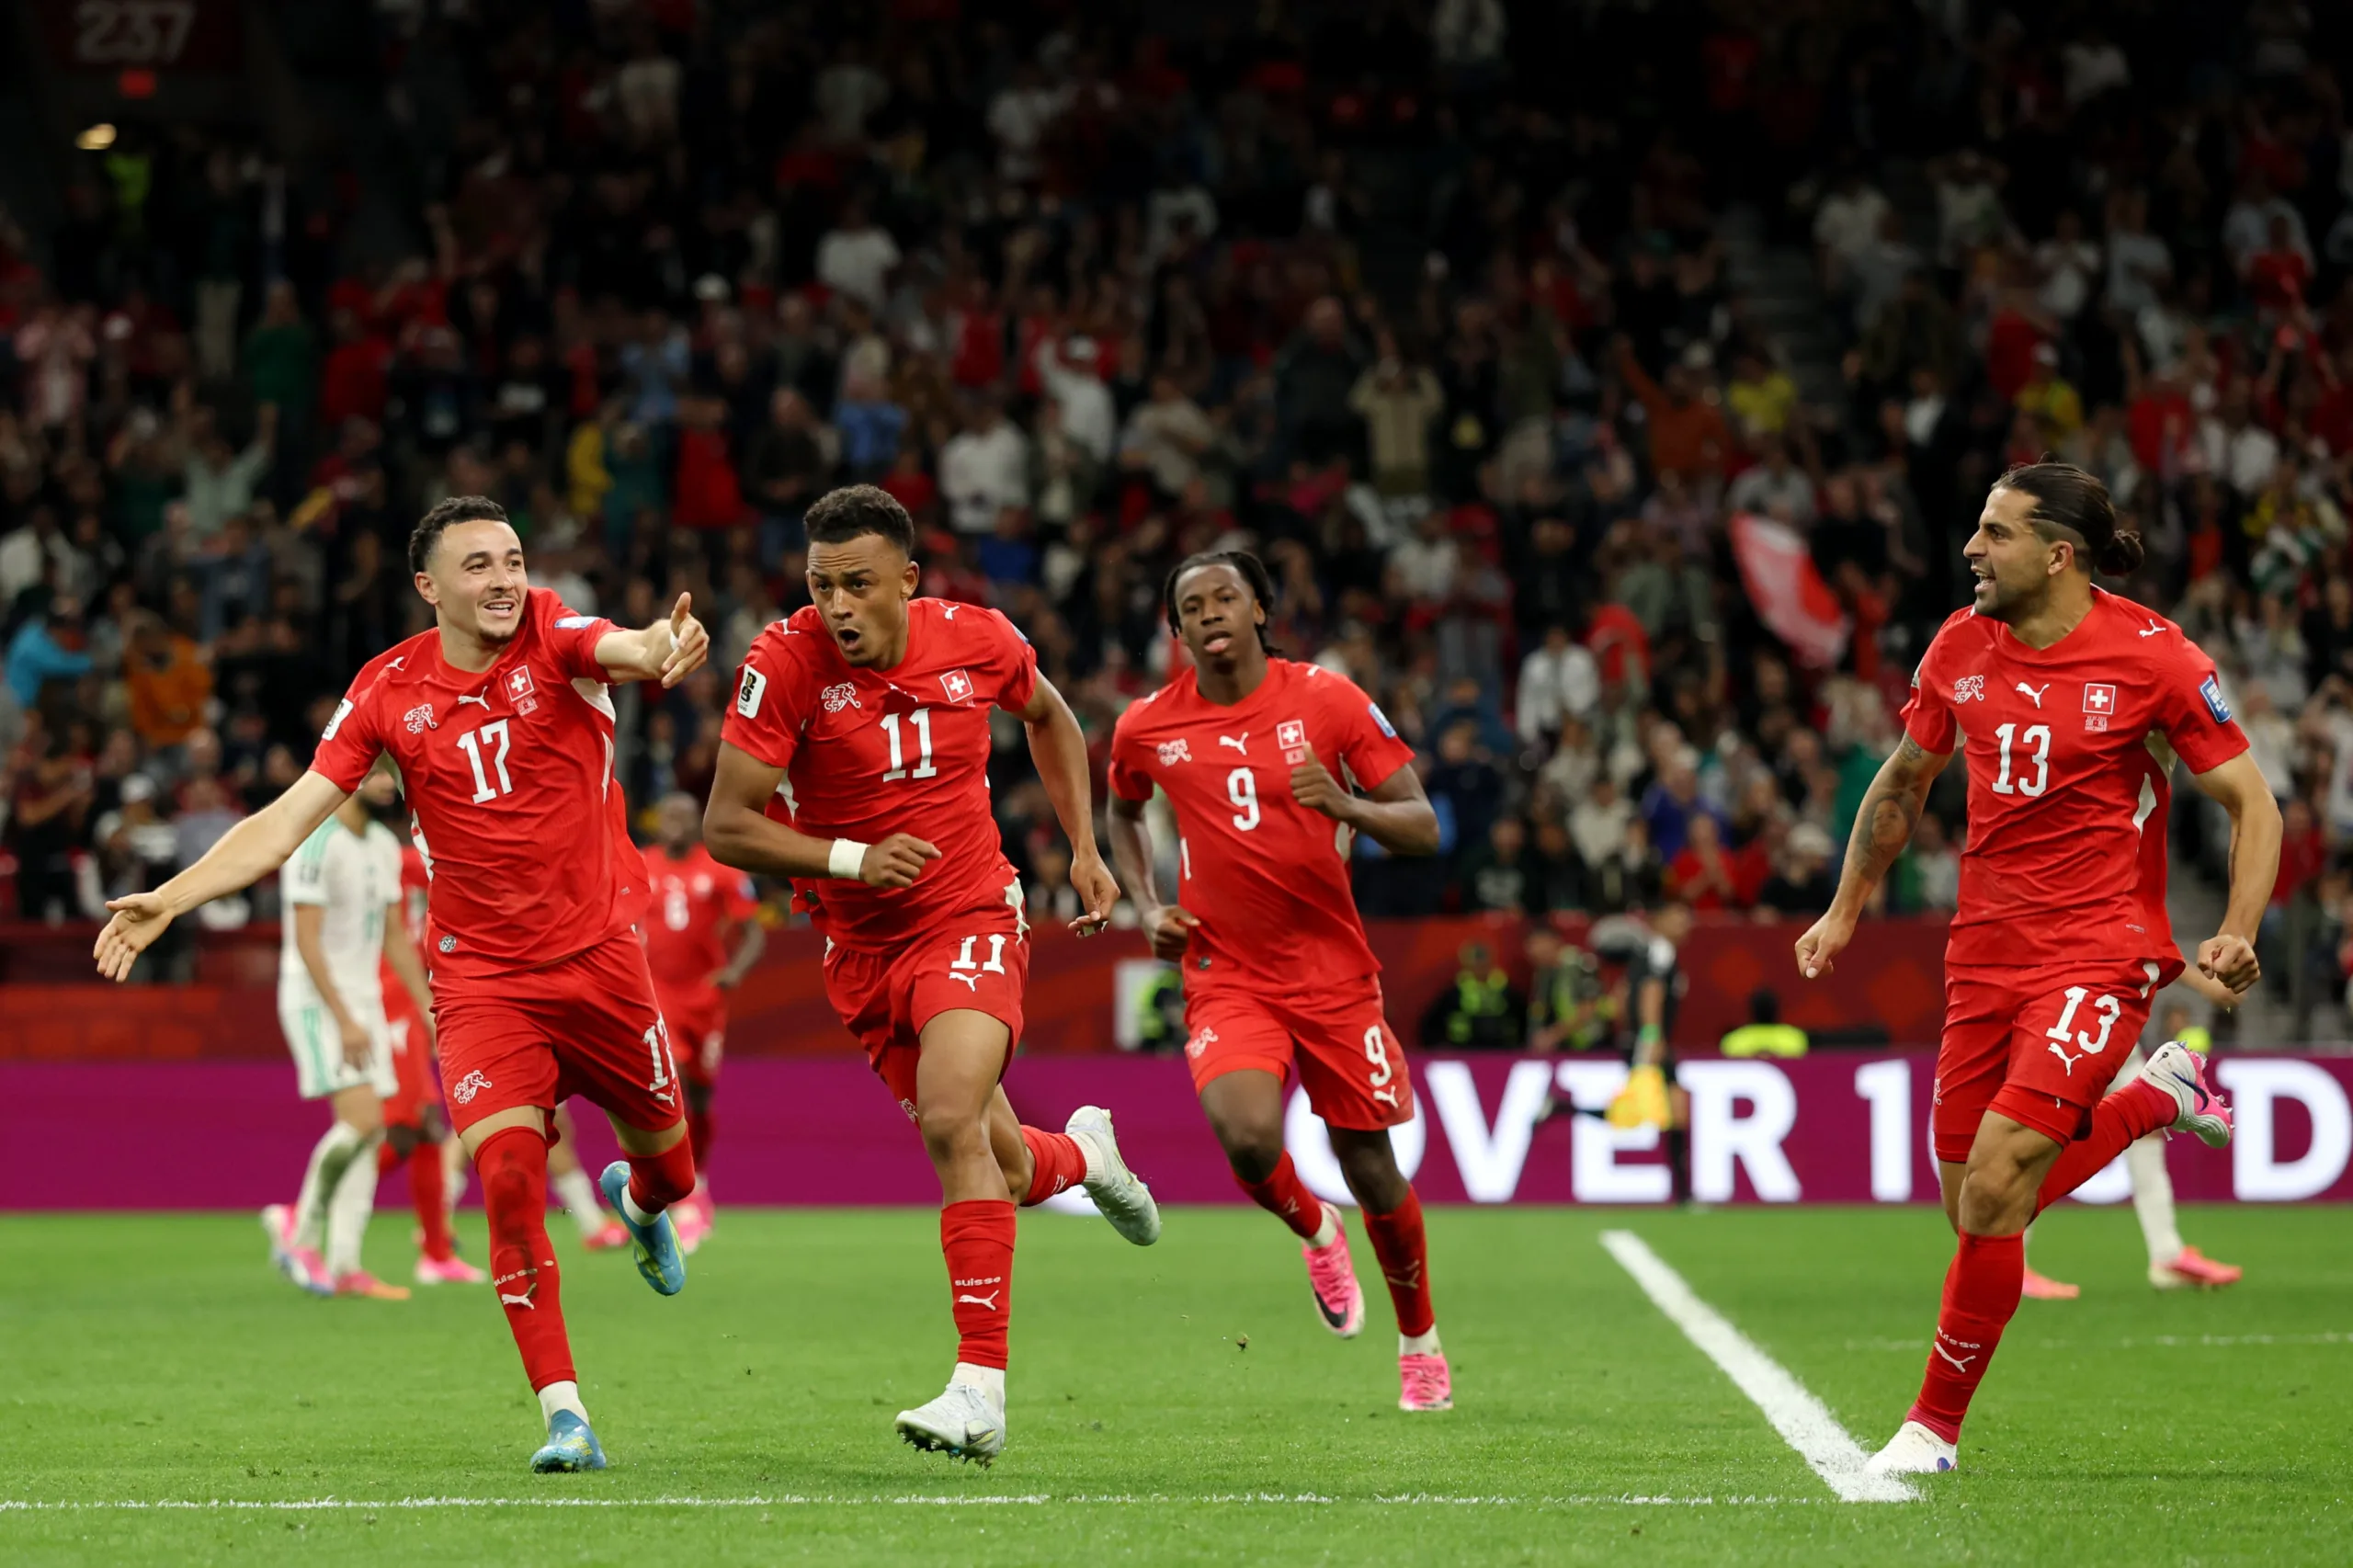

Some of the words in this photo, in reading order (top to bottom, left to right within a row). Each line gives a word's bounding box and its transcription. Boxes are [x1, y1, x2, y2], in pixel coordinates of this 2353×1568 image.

[74, 0, 196, 64] 237
[456, 718, 513, 804] 17
[880, 707, 938, 783] 11
[1992, 722, 2052, 797] 13
[1227, 767, 1261, 832] 9
[950, 933, 1007, 975] 11
[2045, 985, 2121, 1055] 13
[1363, 1024, 1392, 1087] 9
[1284, 1059, 1802, 1206] OVER
[954, 1276, 1001, 1287] suisse
